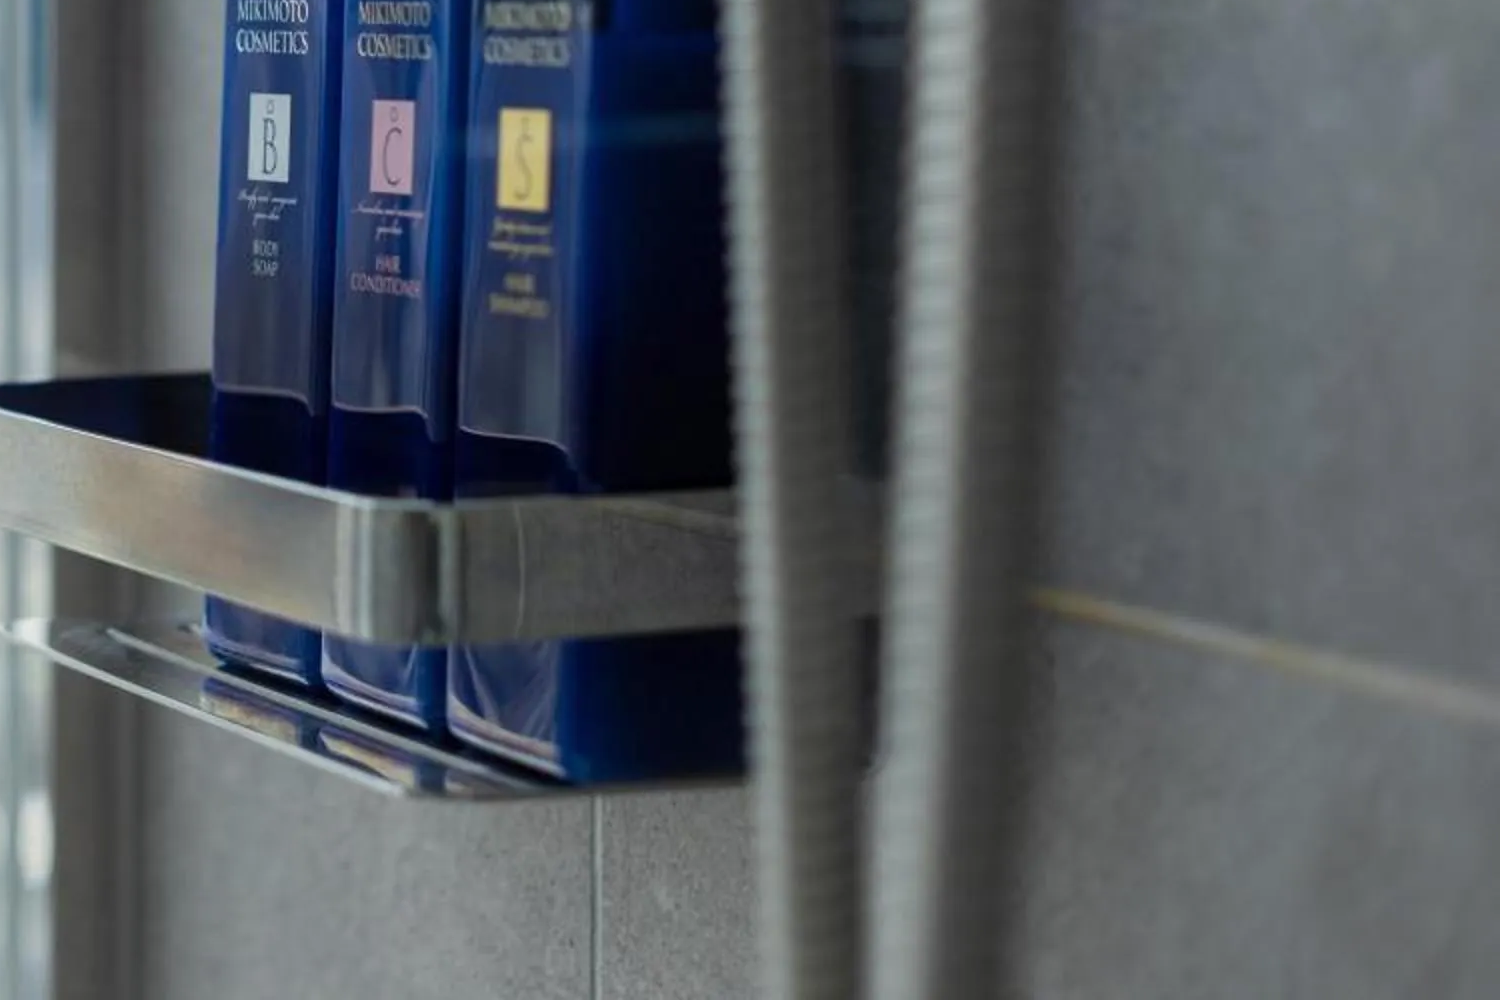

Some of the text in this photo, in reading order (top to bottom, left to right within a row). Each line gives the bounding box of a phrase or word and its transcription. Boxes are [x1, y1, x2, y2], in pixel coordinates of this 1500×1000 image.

[237, 0, 309, 23] MIKIMOTO
[358, 0, 432, 27] MIKIMOTO
[236, 28, 308, 54] COSMETICS
[357, 33, 432, 60] COSMETICS
[262, 117, 278, 174] B
[382, 126, 402, 186] C
[513, 133, 534, 201] S
[252, 258, 278, 277] SOAP
